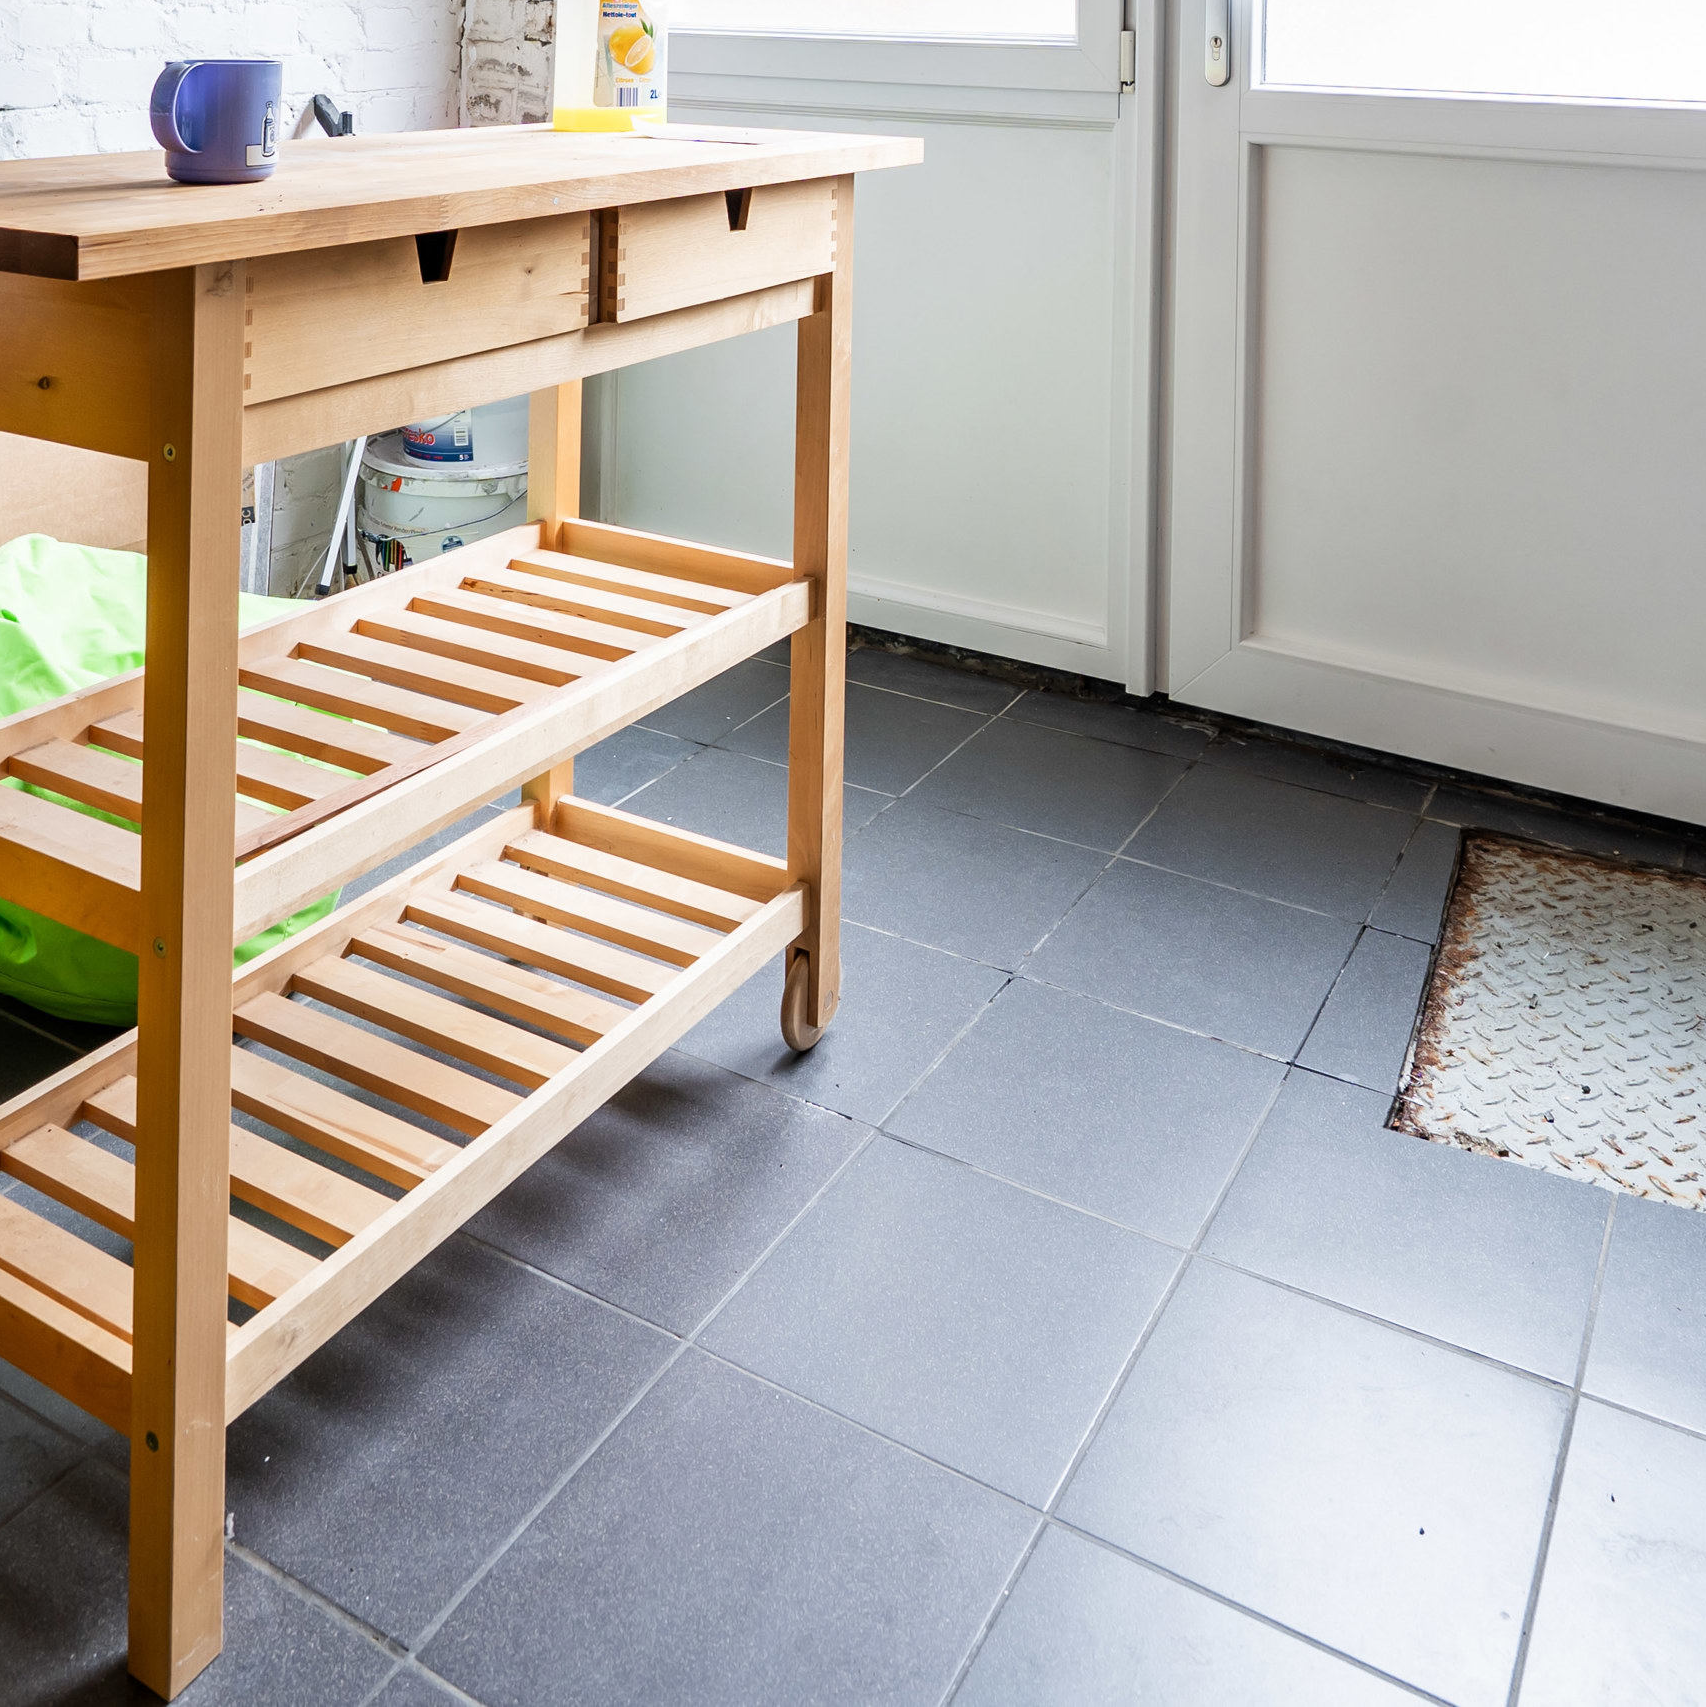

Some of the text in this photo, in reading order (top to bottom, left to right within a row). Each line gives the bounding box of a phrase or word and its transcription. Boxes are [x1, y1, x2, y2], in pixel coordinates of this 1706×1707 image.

[601, 1, 639, 11] Allesreiniger
[601, 10, 638, 20] Nettoie-tout
[649, 88, 660, 100] 2L
